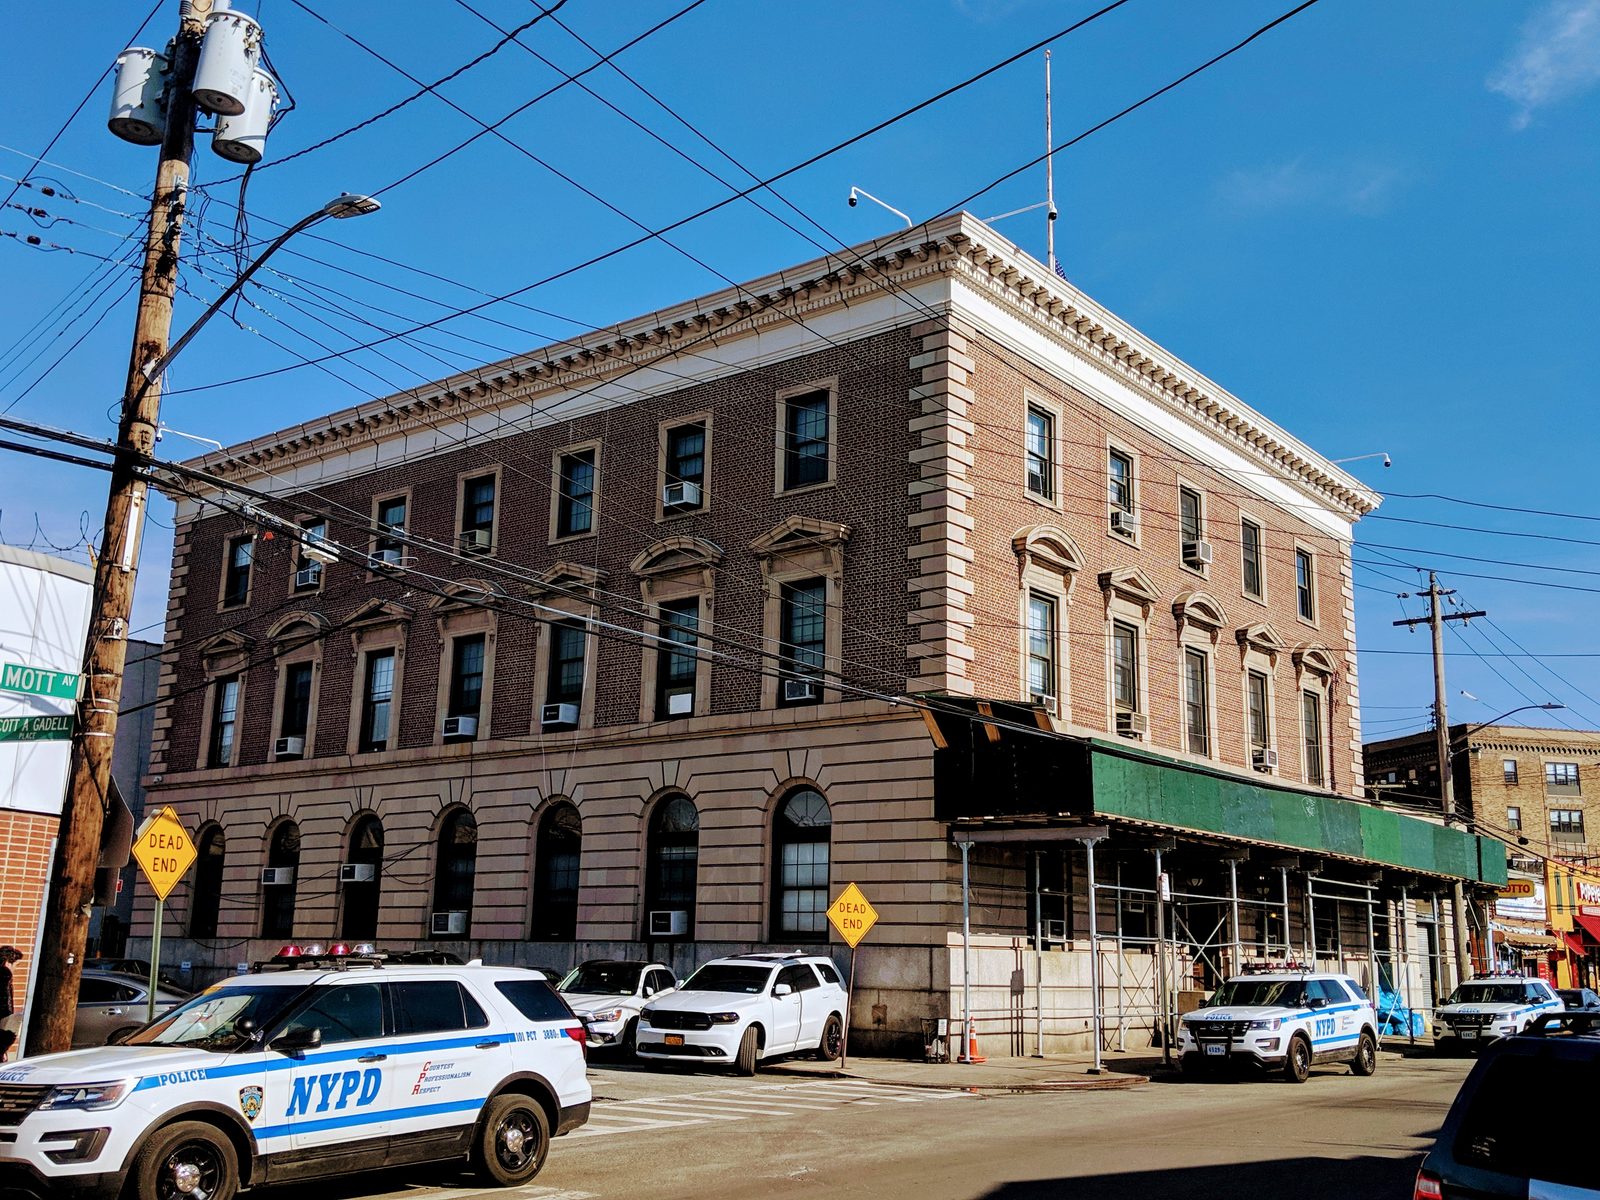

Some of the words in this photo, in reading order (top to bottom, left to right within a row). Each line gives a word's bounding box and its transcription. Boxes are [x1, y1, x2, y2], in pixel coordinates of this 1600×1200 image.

[5, 665, 57, 693] MOTT
[61, 675, 75, 687] AV
[0, 718, 20, 732] COTT
[21, 718, 29, 732] A
[32, 716, 69, 731] GADELL
[18, 731, 37, 740] PLACE
[149, 833, 184, 850] DEAD
[152, 857, 178, 873] END
[839, 902, 867, 914] DEAD
[843, 918, 863, 930] END
[1316, 1018, 1336, 1037] NYPD
[526, 1031, 537, 1041] PCT
[423, 1061, 455, 1072] COURTESY
[0, 1072, 29, 1083] LICE
[159, 1068, 207, 1086] POLICE
[417, 1071, 472, 1083] PROFESSIONALISM
[285, 1067, 383, 1117] NYPD
[411, 1084, 441, 1095] RESPECT
